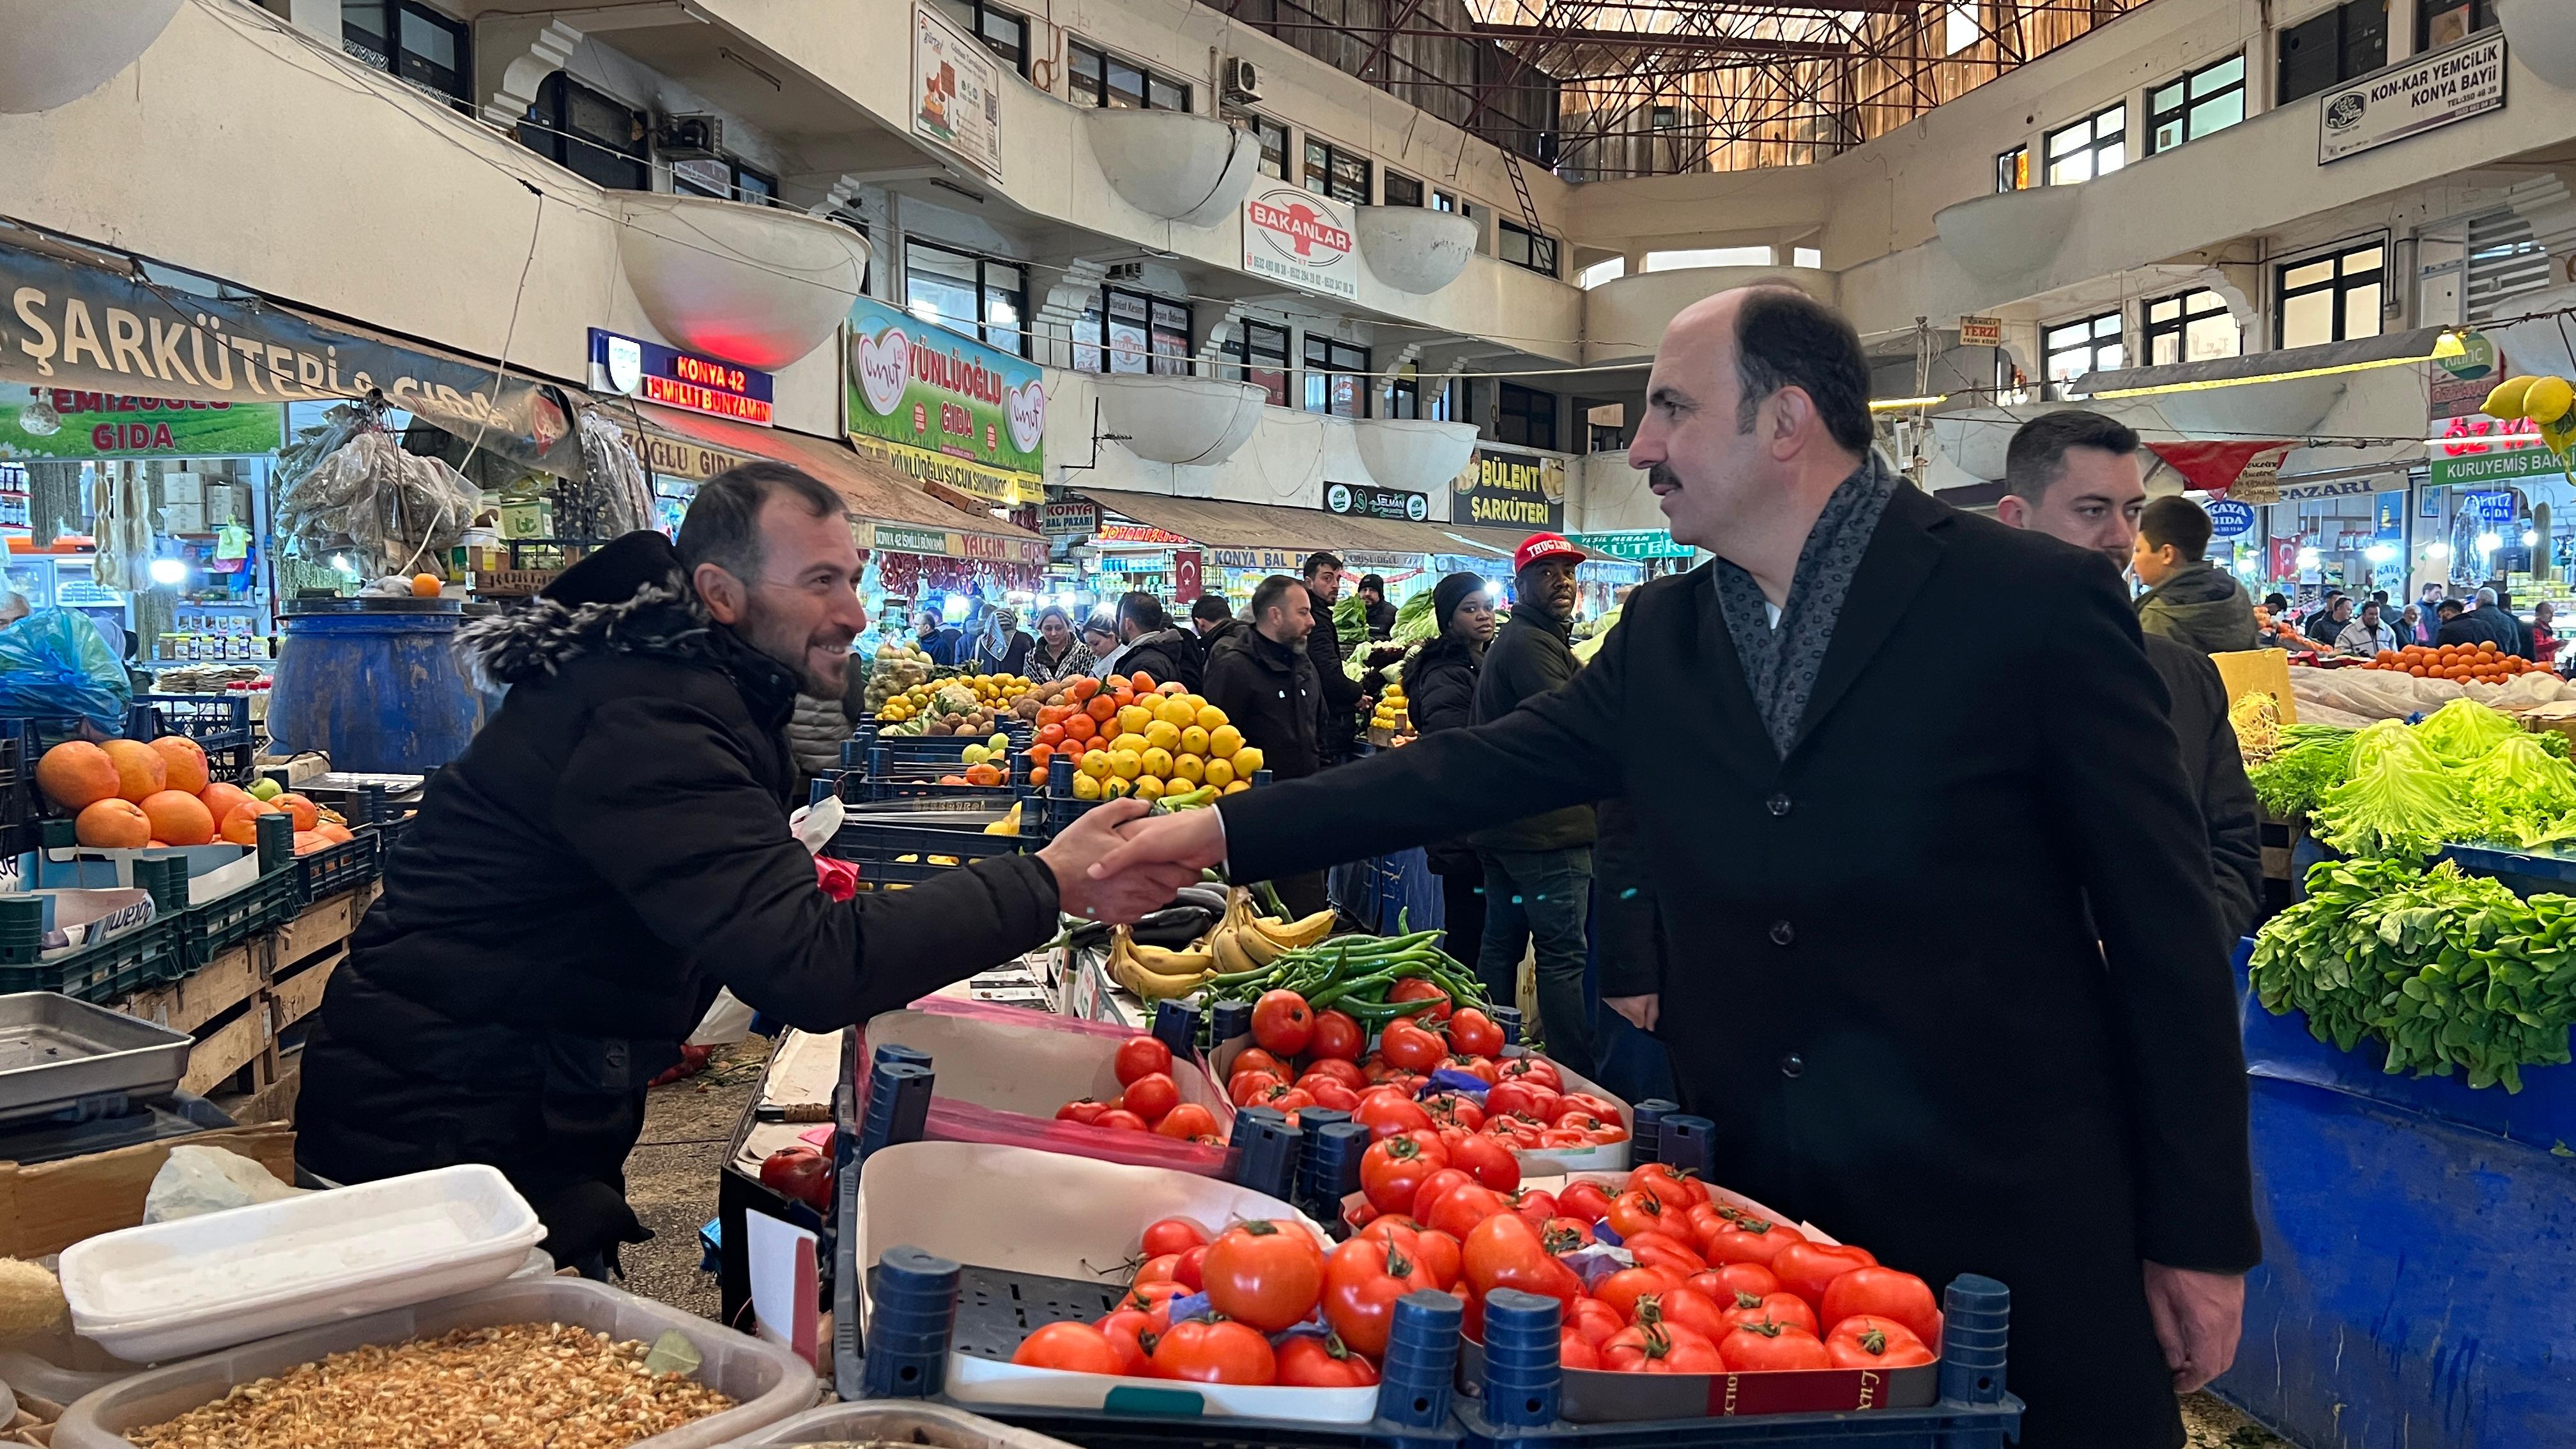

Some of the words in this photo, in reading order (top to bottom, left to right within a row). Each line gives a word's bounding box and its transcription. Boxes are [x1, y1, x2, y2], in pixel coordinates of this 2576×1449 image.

[2371, 70, 2428, 103] KON-KAR
[2411, 80, 2457, 108] KONYA
[1255, 206, 1346, 249] BAKANLAR
[1110, 297, 1126, 311] Dürüst
[1128, 300, 1144, 314] Kesim
[1153, 308, 1167, 321] Peşin
[1168, 309, 1186, 325] Ödeme
[13, 286, 351, 397] ŞARKÜTERİ
[1964, 326, 1998, 337] TERZİ
[678, 356, 726, 387] KONYA
[728, 369, 745, 392] 42
[865, 348, 901, 390] umut
[908, 335, 1001, 406] YÜNLÜOĞLU
[940, 401, 974, 439] GIDA
[1014, 397, 1039, 431] umut
[92, 422, 176, 451] GIDA
[2443, 417, 2489, 456] ÖZ
[1482, 456, 1540, 493] BÜLENT
[2447, 455, 2527, 479] KURUYEMİŞ
[2279, 480, 2373, 500] PAZARI
[1046, 503, 1092, 516] KONYA
[1046, 518, 1061, 527] BAL
[1064, 517, 1092, 526] PAZARI
[1471, 496, 1549, 525] ŞARKÜTERİ
[2209, 503, 2248, 517] KAYA
[2212, 516, 2244, 525] GIDA
[2483, 509, 2508, 518] GDA
[960, 535, 1006, 558] YALÇIN
[1215, 550, 1255, 566] KONYA
[1264, 552, 1287, 567] BAL
[1527, 540, 1554, 557] THUG
